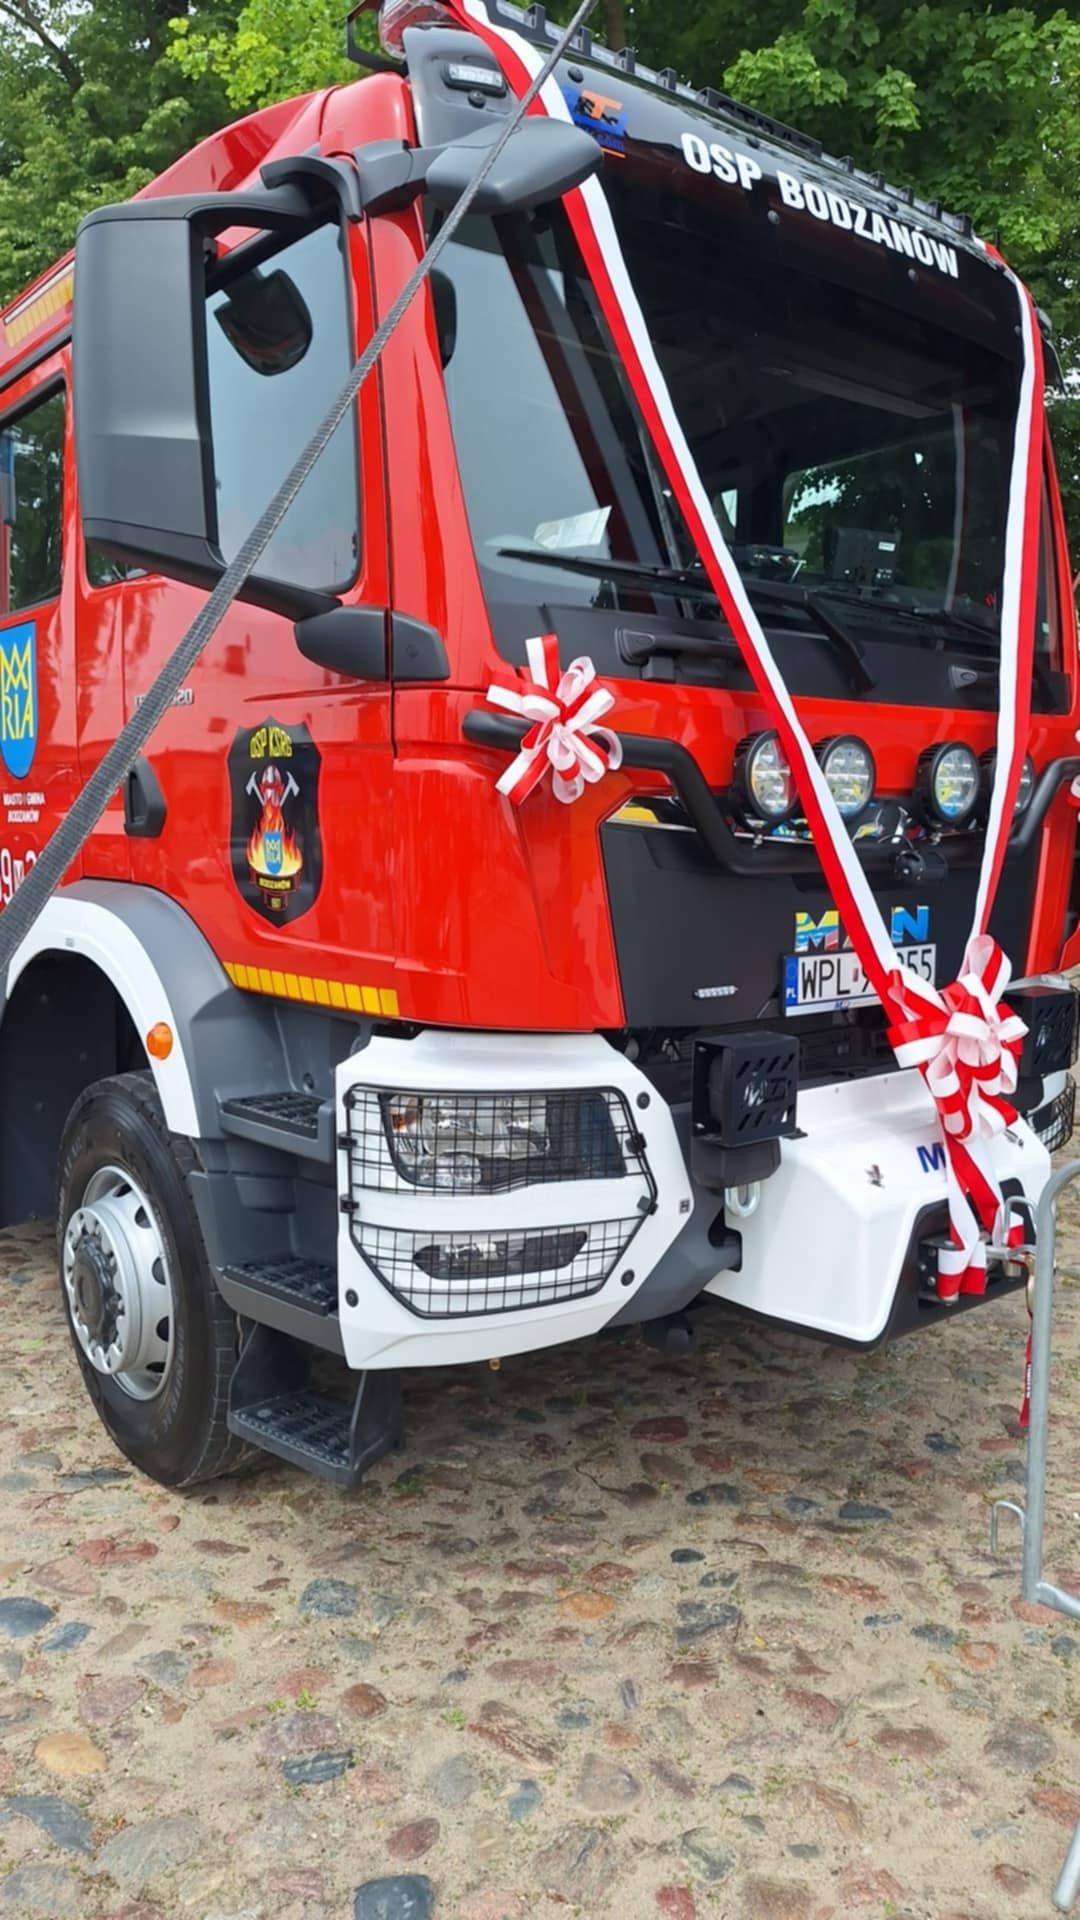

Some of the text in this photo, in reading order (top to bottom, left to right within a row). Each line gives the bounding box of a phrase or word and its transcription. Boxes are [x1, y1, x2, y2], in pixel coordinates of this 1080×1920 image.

[680, 132, 960, 279] OSP BODZANÓW
[794, 904, 930, 953] MN
[801, 957, 850, 1001] WPL
